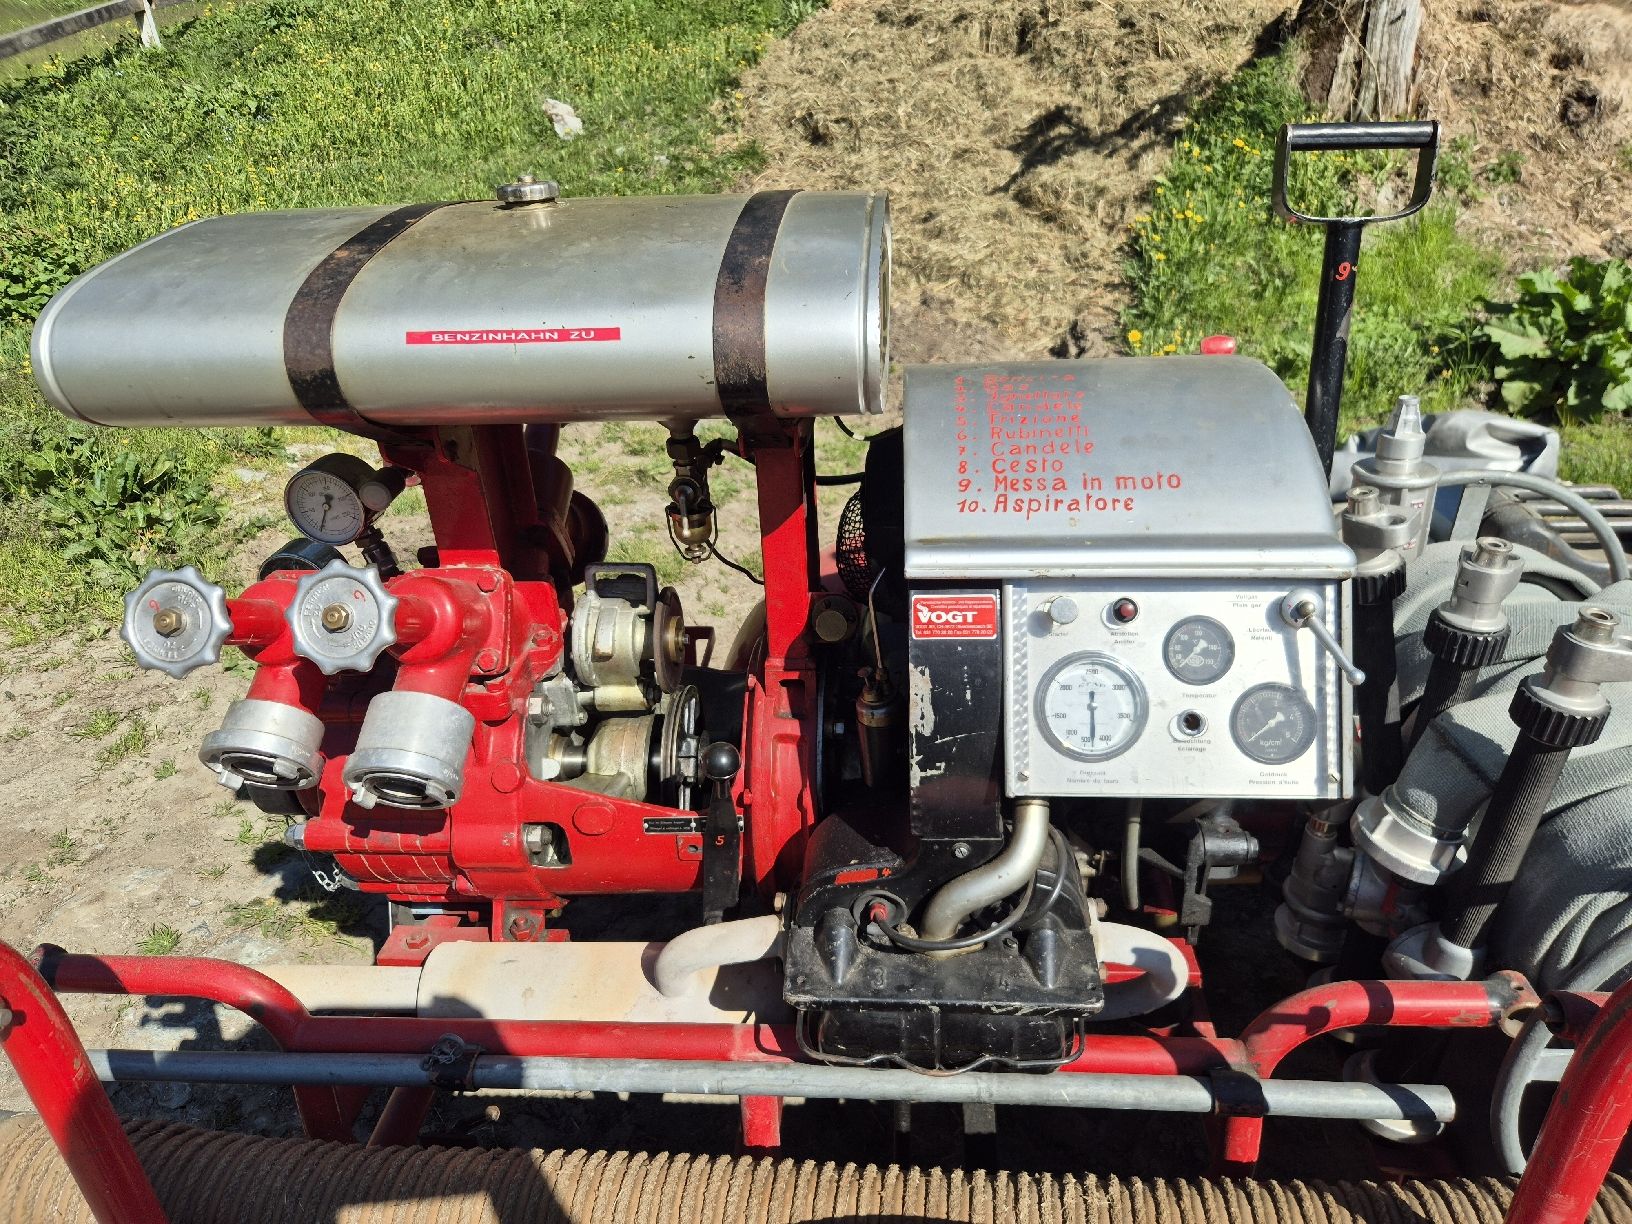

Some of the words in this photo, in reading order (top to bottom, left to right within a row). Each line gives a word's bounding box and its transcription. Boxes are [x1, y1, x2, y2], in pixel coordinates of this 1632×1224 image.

[1336, 261, 1351, 281] 9
[431, 331, 559, 342] BENZINHAHN
[570, 330, 595, 340] ZU
[988, 400, 1083, 414] Candele
[956, 415, 977, 428] 5.
[988, 412, 1082, 427] Frizione
[957, 430, 977, 442] 6.
[957, 446, 978, 457] 7.
[991, 441, 1095, 457] Candele
[957, 460, 980, 475] 8.
[991, 457, 1064, 475] Cesto
[957, 478, 982, 493] 9.
[993, 475, 1068, 493] Messa
[1081, 472, 1103, 491] in
[1115, 471, 1182, 491] moto
[956, 499, 987, 513] 10.
[993, 493, 1135, 521] Aspiratore
[917, 610, 978, 624] VOGT
[715, 834, 725, 846] 5
